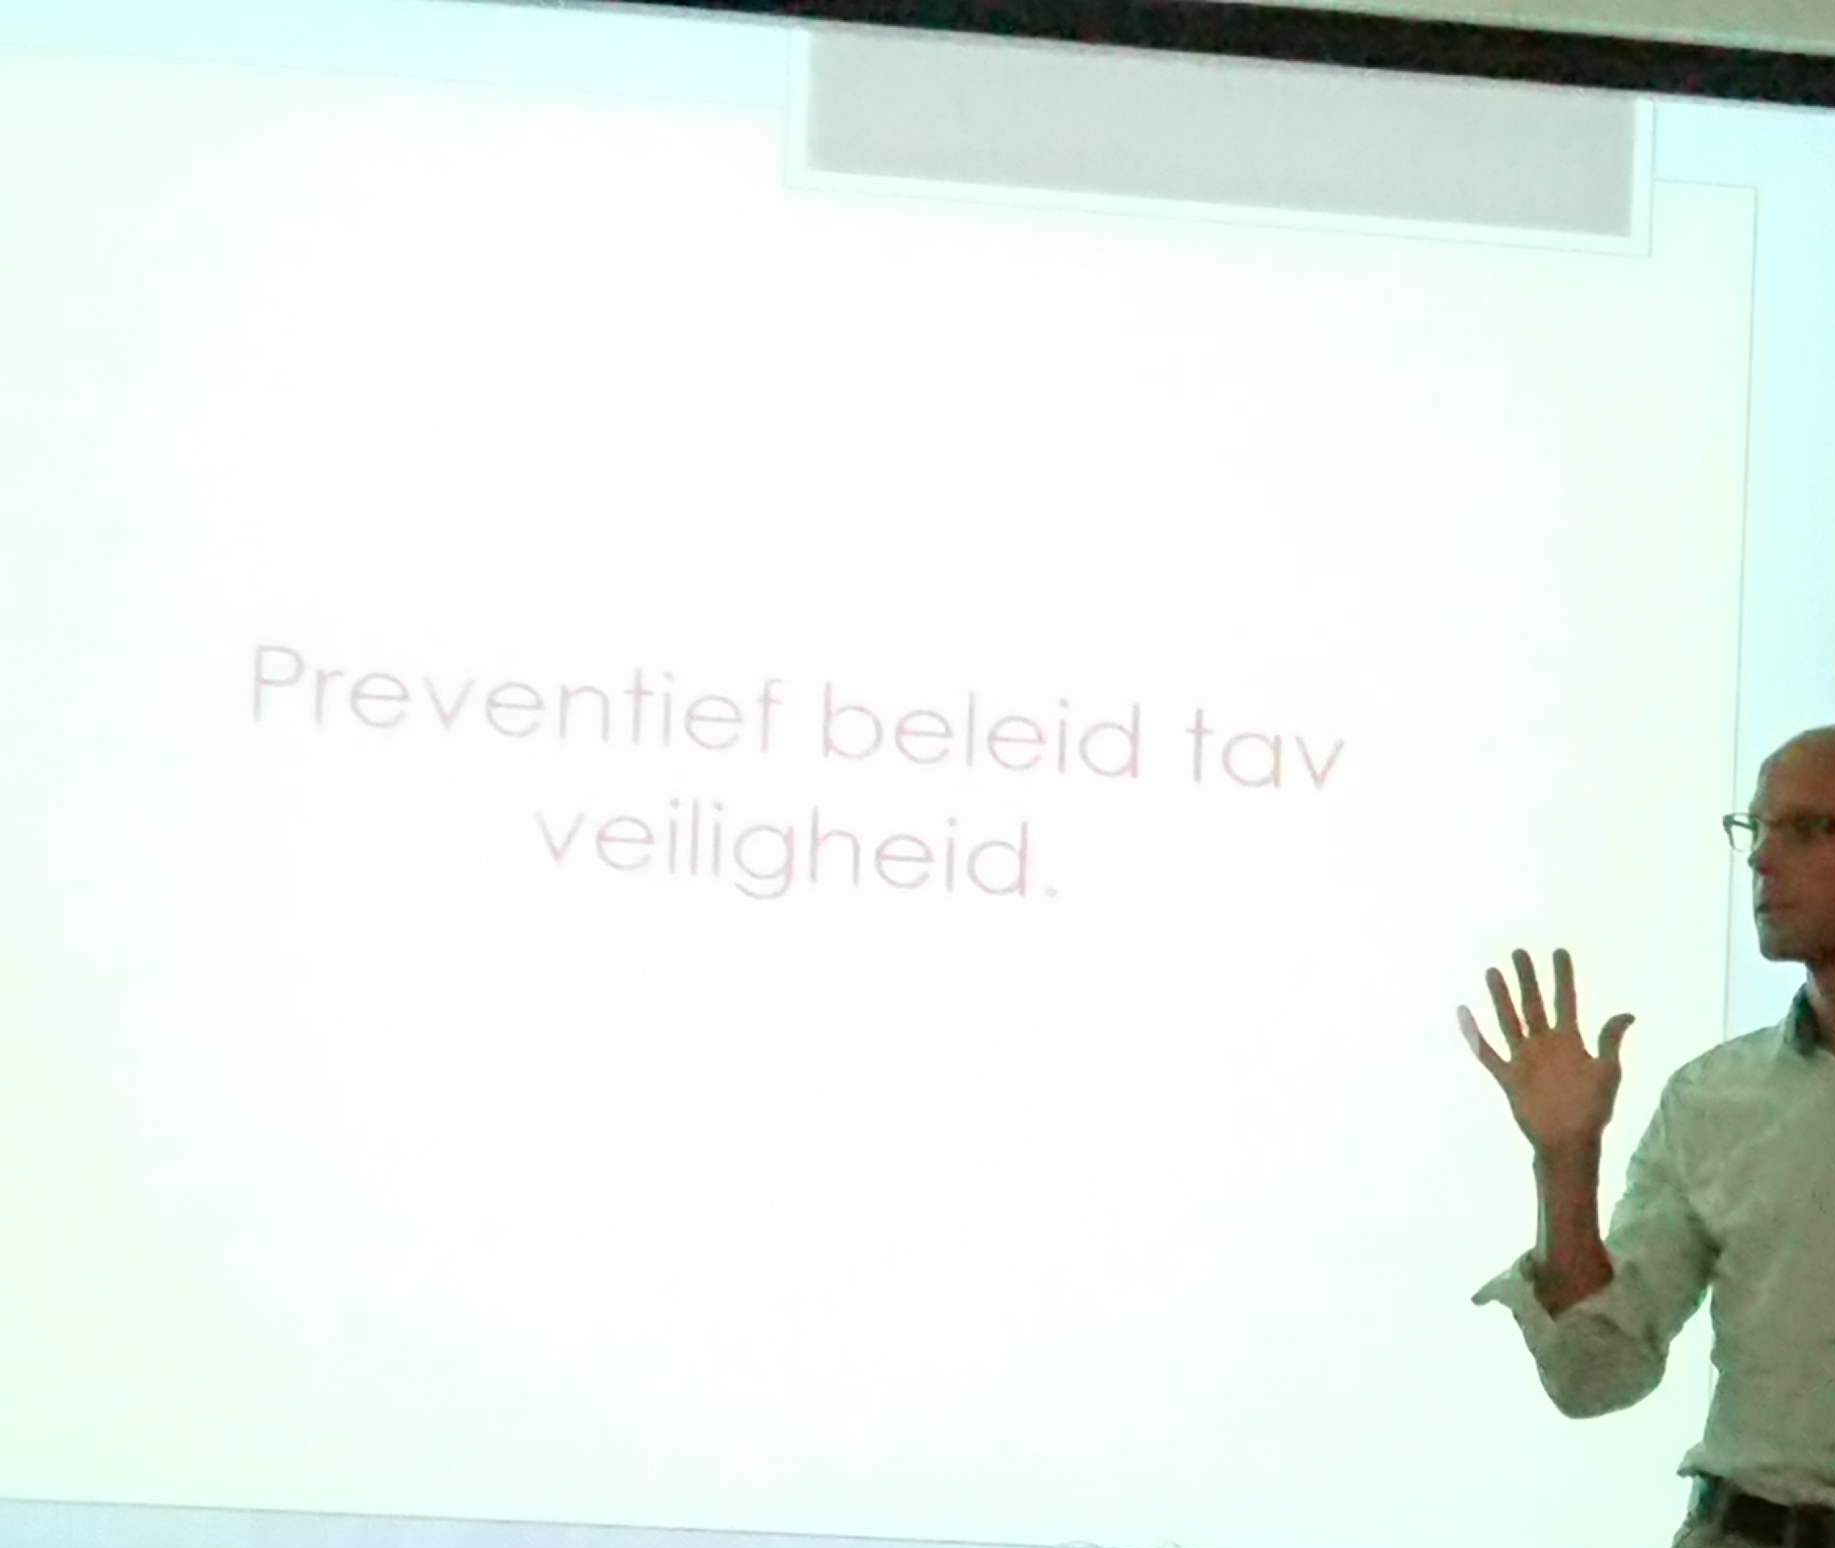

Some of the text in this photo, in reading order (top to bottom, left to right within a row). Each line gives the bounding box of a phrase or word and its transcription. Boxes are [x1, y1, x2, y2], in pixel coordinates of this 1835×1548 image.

[250, 643, 1346, 793] Preventief beleid tav
[535, 797, 1060, 900] veiligheid.
